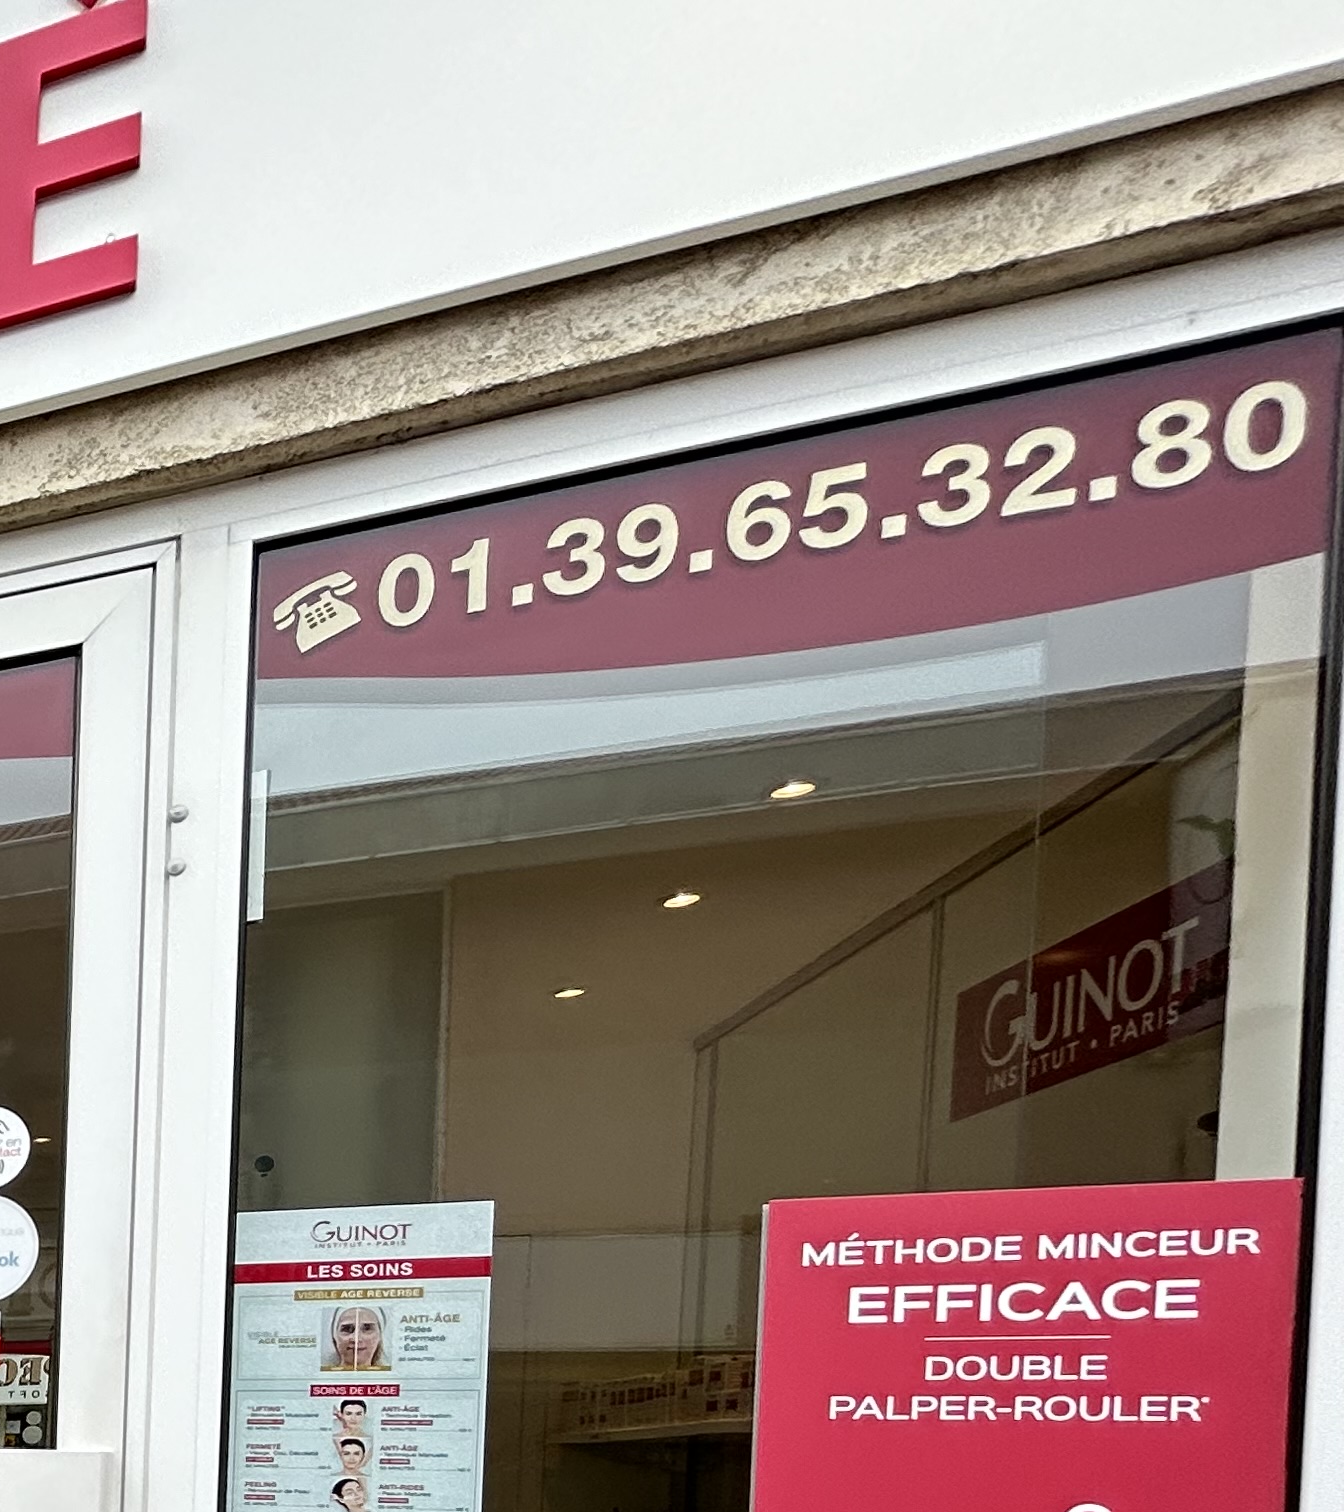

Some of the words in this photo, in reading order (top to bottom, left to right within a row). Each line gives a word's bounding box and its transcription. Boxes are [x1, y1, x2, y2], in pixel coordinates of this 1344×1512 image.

[377, 381, 1310, 628] 01.39.65.32.80
[980, 916, 1200, 1068] GUINOT
[1108, 1000, 1181, 1048] PARIS
[310, 1220, 413, 1243] GUINOT
[800, 1232, 1023, 1267] MÉTHODE
[1036, 1228, 1261, 1262] MINCEUR
[306, 1264, 344, 1279] LES
[350, 1262, 414, 1278] SOINS
[846, 1278, 1201, 1325] EFFICACE
[923, 1354, 1109, 1382] DOUBLE
[349, 1386, 365, 1395] DE
